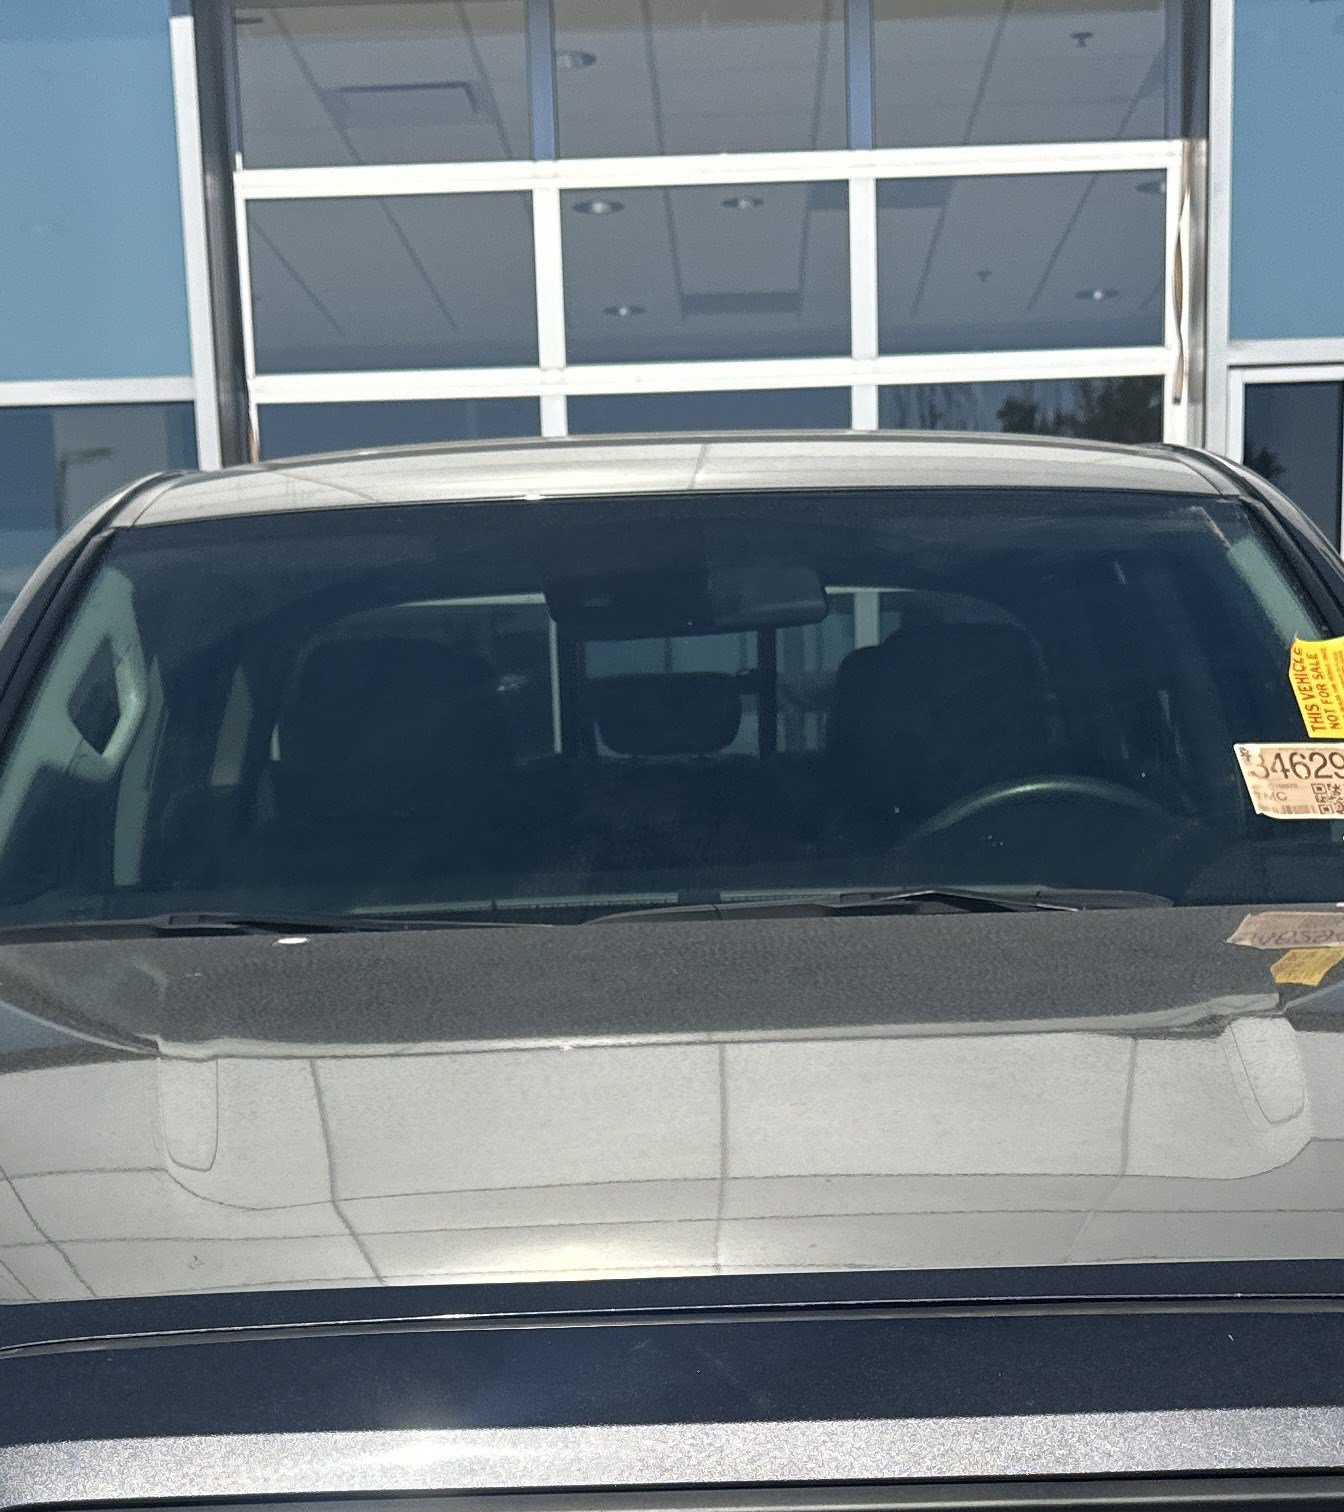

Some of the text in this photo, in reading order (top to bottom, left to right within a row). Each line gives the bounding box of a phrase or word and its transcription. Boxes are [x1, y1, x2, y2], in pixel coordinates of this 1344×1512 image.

[1306, 652, 1323, 680] SALE
[1293, 647, 1326, 732] THIS VEHICLE
[1316, 683, 1333, 704] FOR
[1324, 708, 1342, 730] NOT
